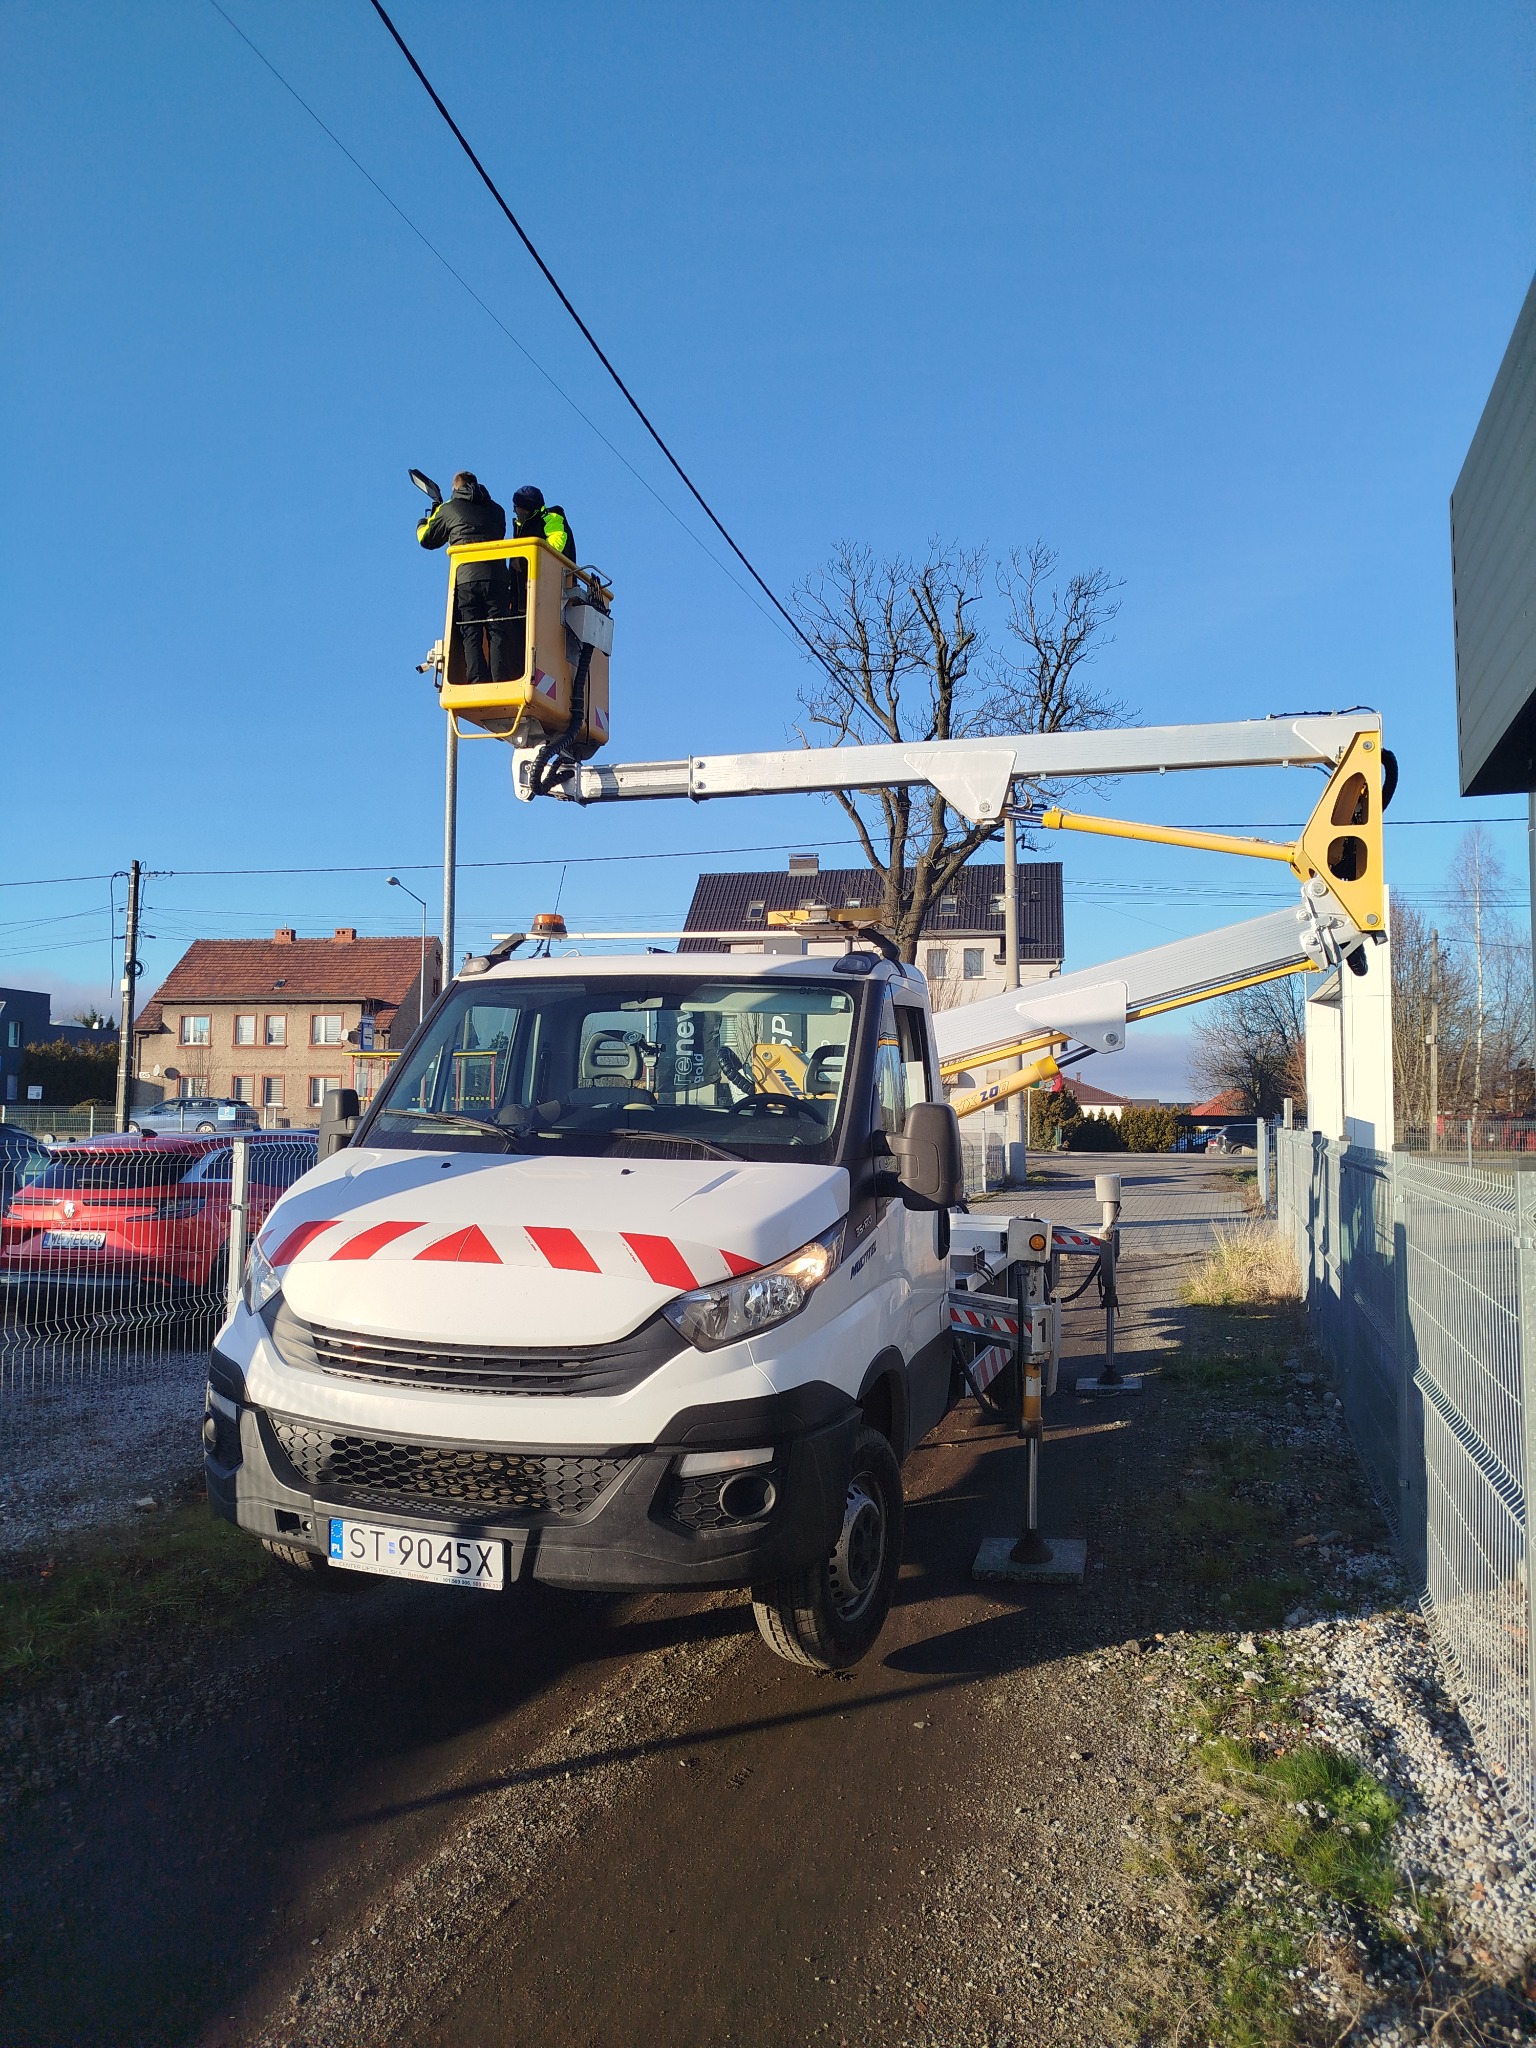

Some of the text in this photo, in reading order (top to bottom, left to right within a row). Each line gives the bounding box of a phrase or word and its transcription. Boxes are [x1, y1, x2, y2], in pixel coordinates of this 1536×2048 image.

[693, 1053, 704, 1084] gold
[1038, 1318, 1046, 1342] 1
[331, 1543, 342, 1554] PL
[350, 1528, 493, 1578] ST 9045X
